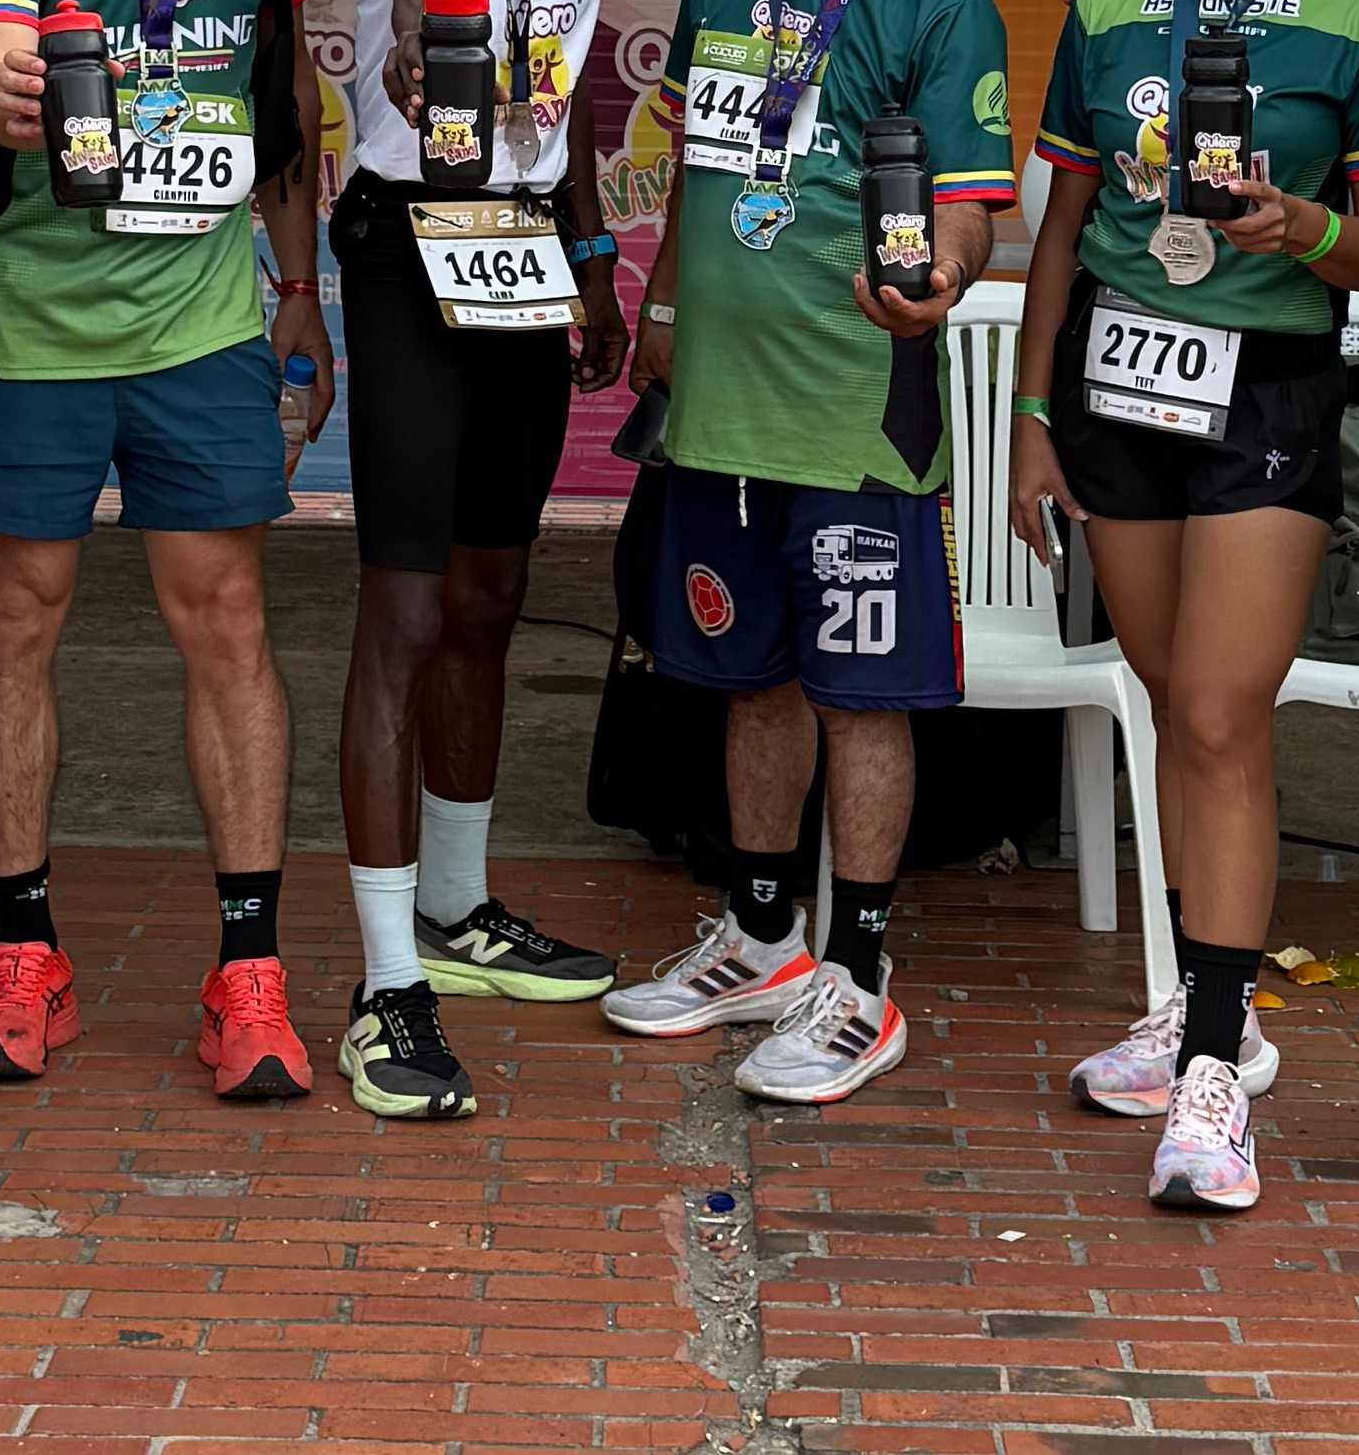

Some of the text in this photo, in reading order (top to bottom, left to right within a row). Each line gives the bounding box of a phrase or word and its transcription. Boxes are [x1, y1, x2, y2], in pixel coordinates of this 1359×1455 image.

[195, 100, 238, 125] 5K
[122, 141, 234, 189] 4426
[445, 248, 547, 288] 1464
[1100, 323, 1208, 383] 2770
[817, 588, 897, 656] 20
